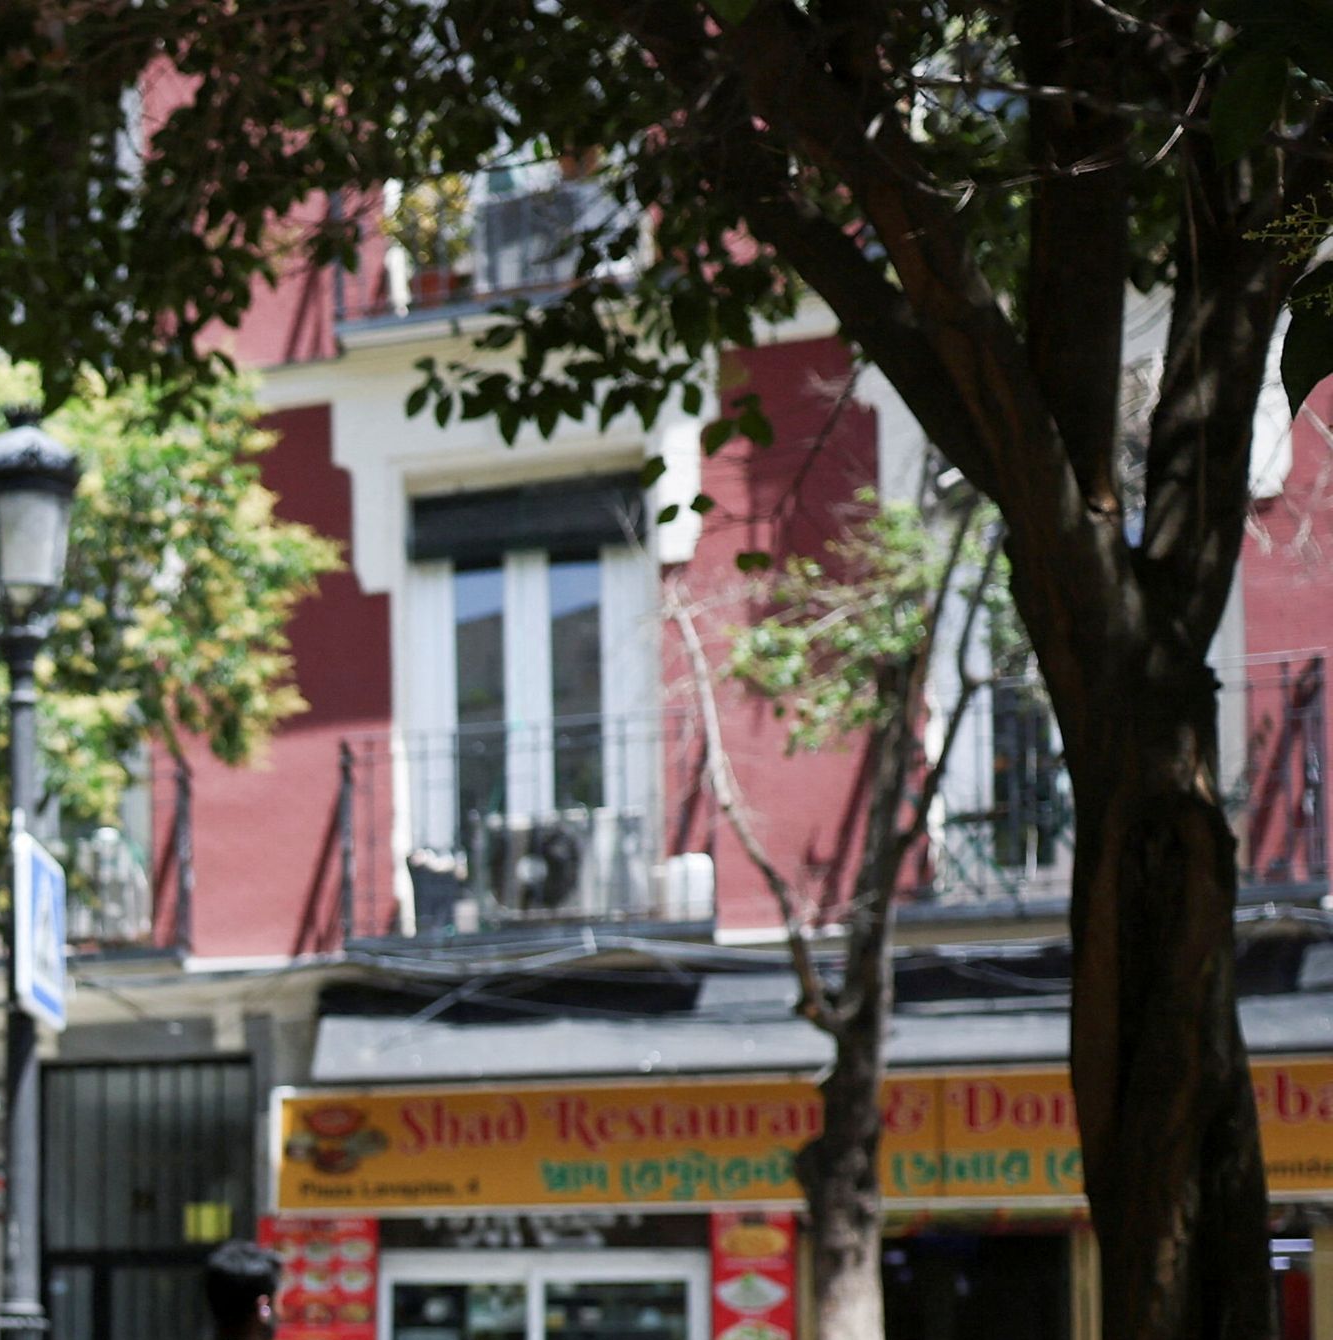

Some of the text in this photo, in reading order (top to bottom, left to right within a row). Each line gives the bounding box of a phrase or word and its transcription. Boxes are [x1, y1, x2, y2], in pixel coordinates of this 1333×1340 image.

[398, 1095, 529, 1156] Shad
[542, 1091, 825, 1153] Restauran
[945, 1080, 1079, 1135] Don
